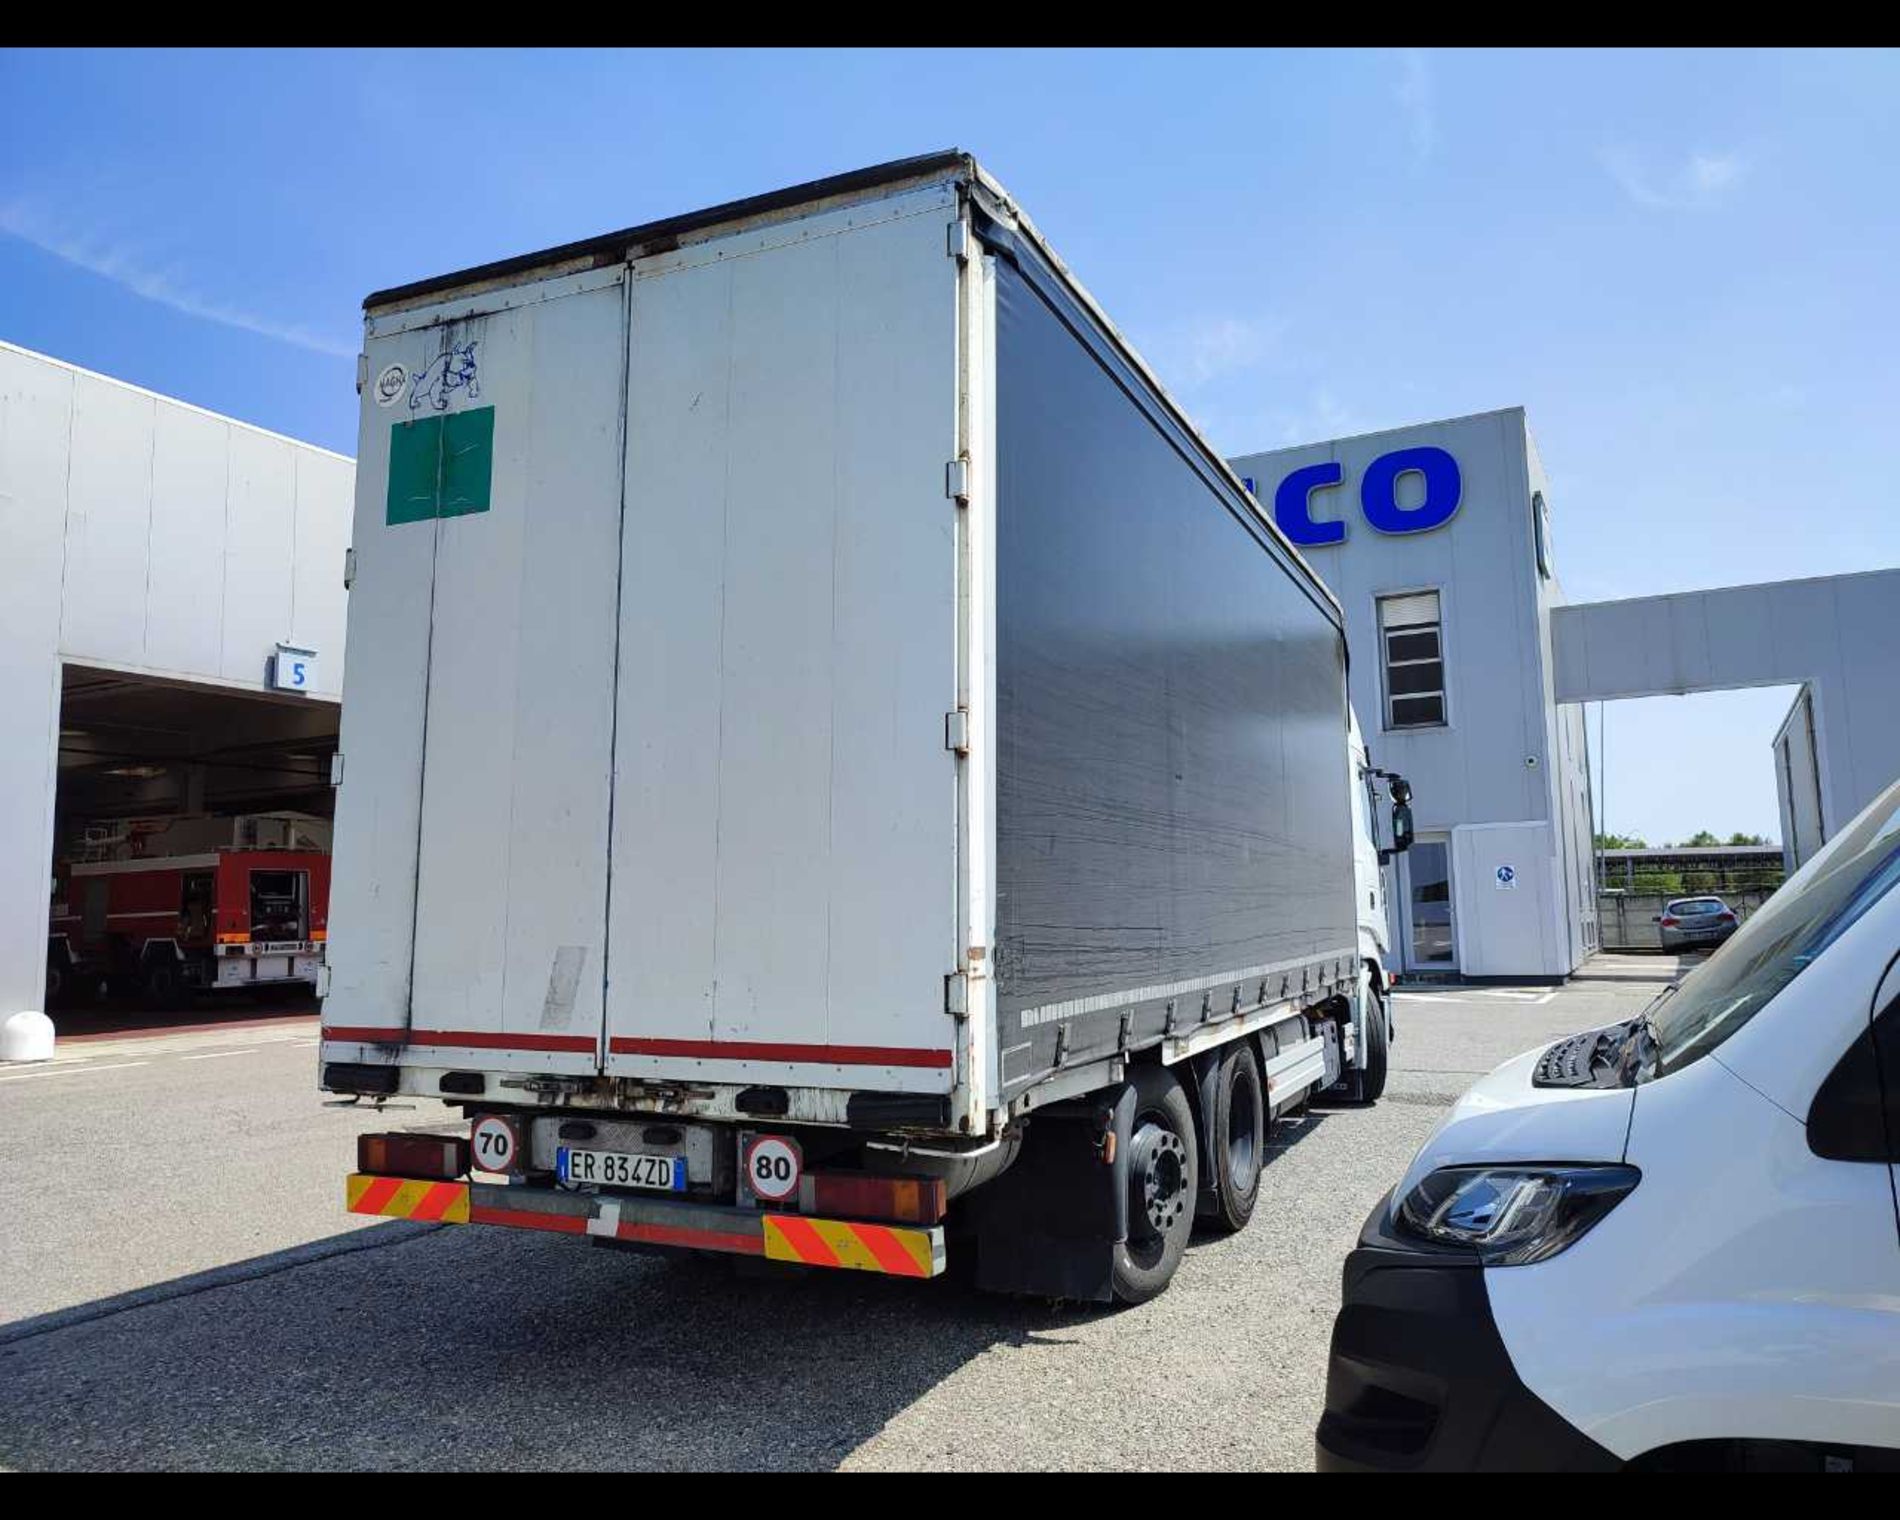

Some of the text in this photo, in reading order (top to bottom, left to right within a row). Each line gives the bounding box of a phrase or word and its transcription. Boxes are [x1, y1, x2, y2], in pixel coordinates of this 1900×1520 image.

[1242, 447, 1461, 545] CO
[293, 663, 305, 685] 5
[479, 1132, 508, 1156] 70
[571, 1152, 670, 1186] ER 834ZD
[756, 1155, 790, 1181] 80
